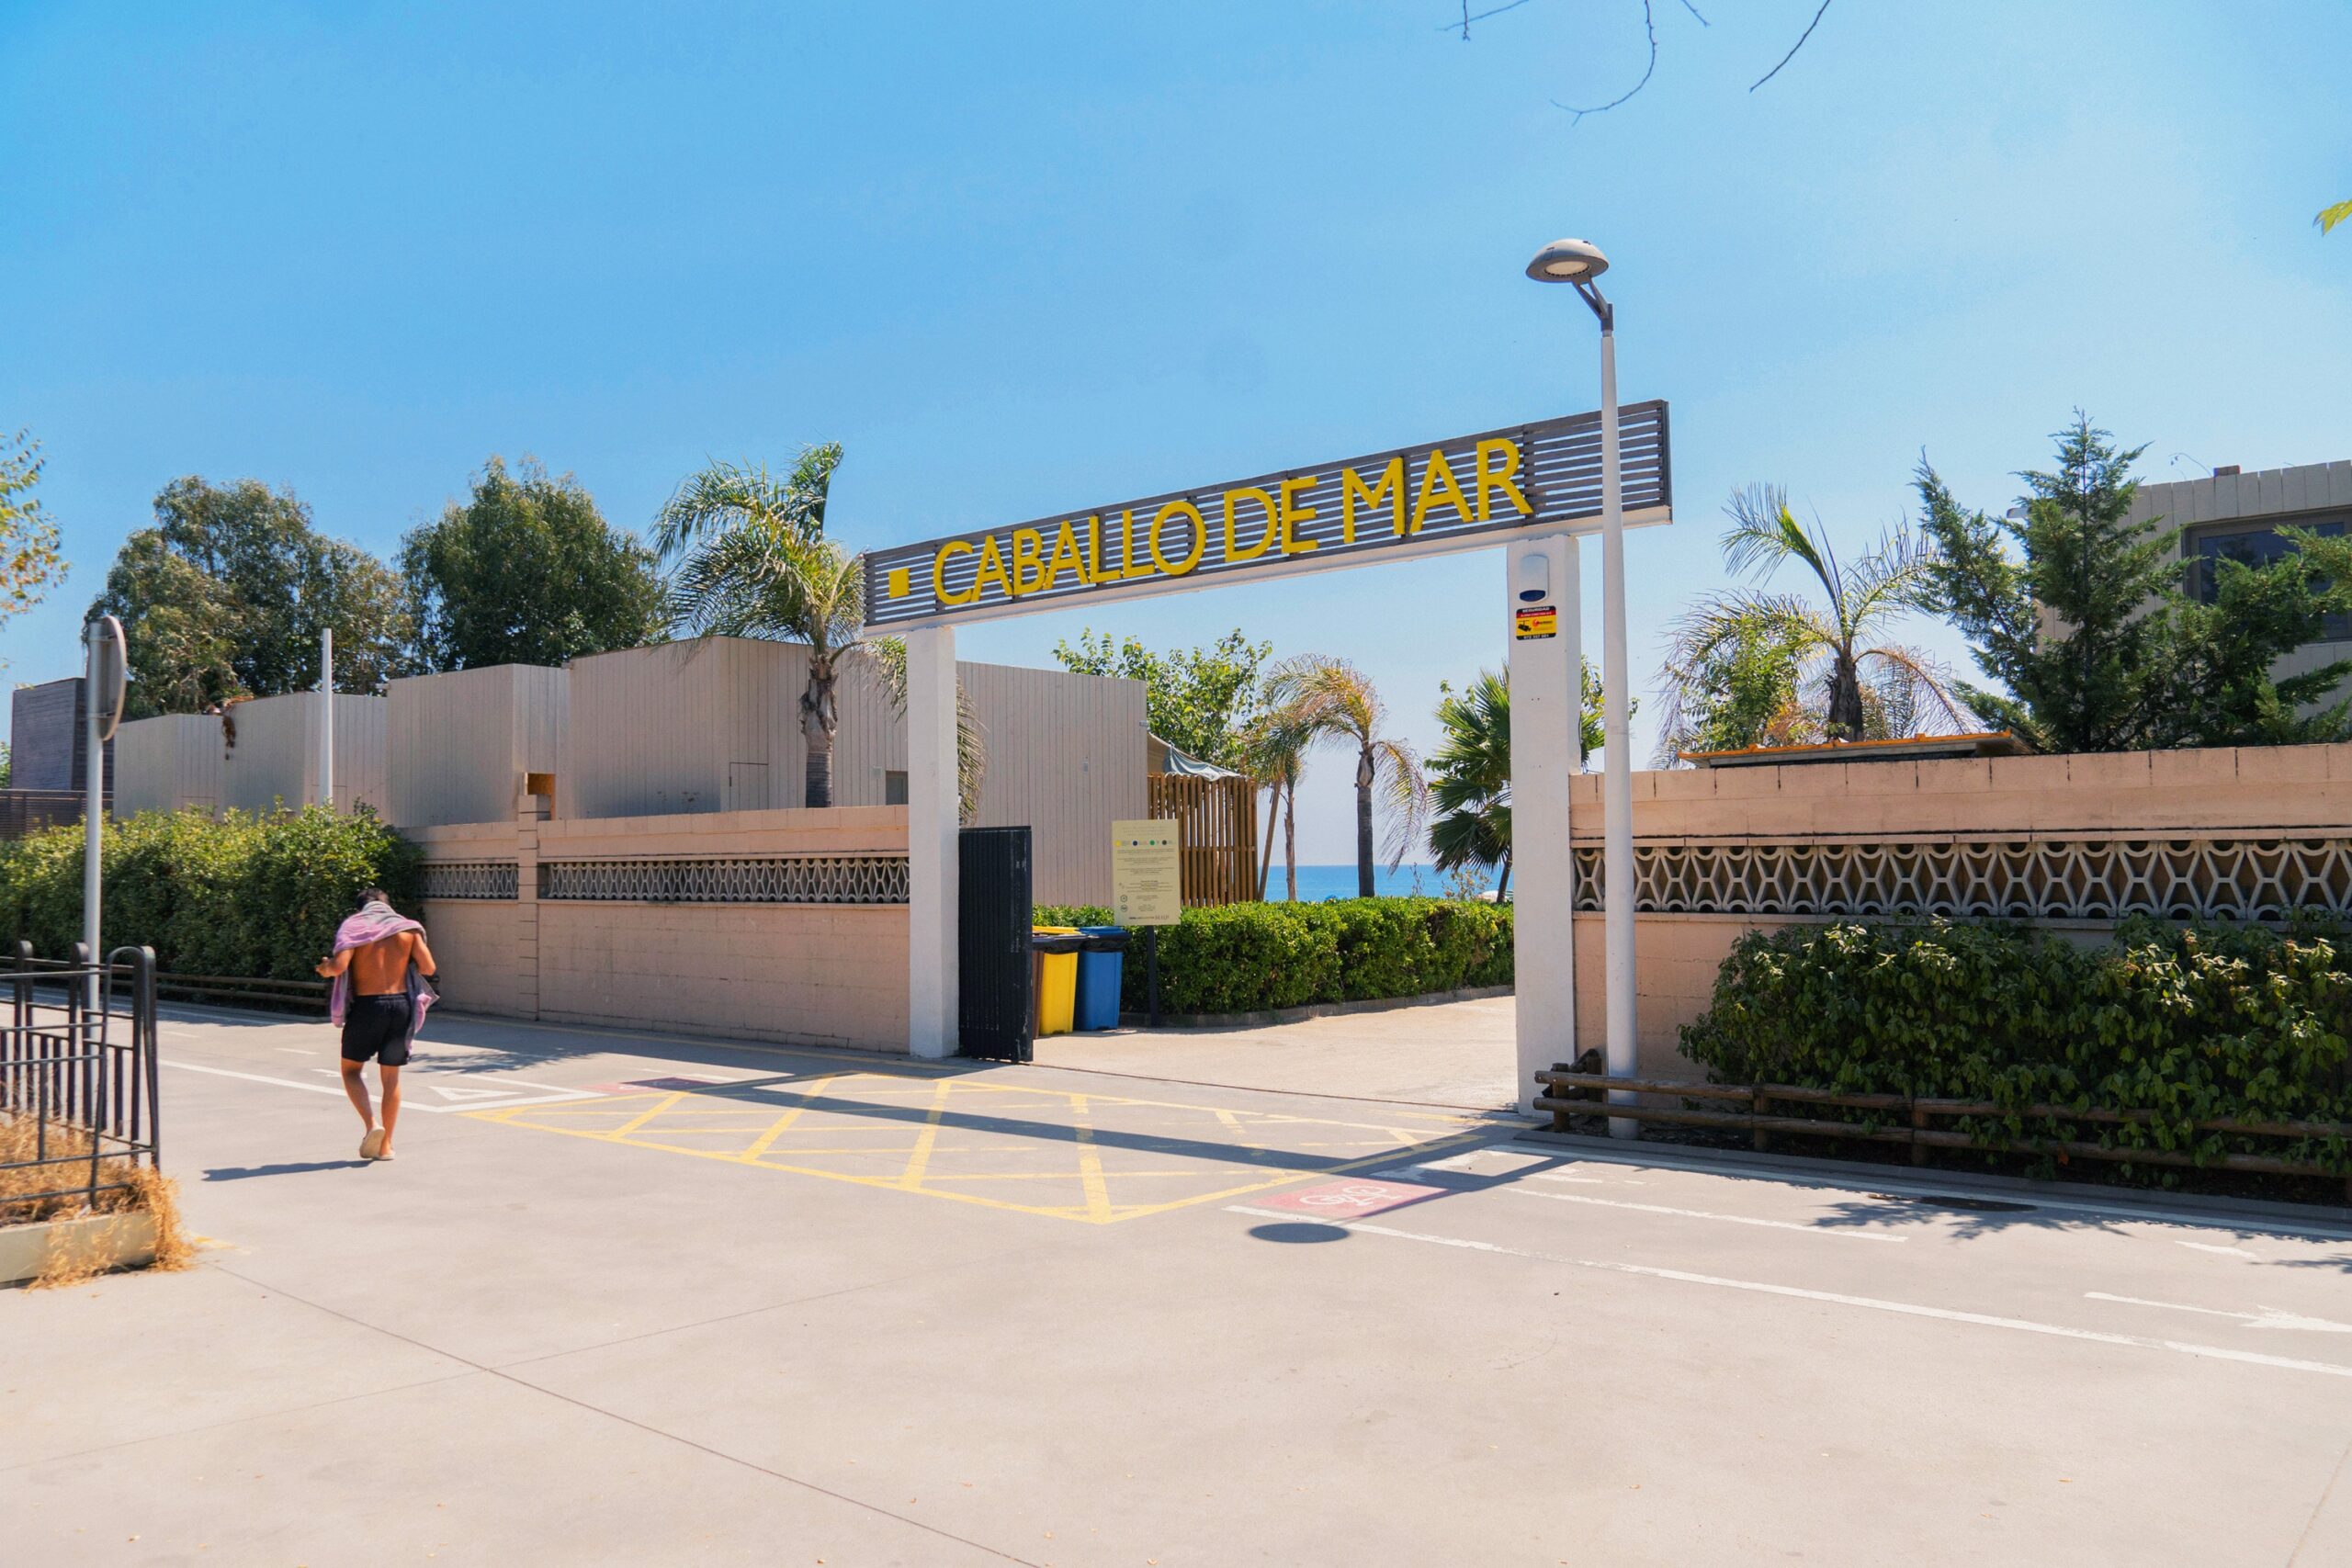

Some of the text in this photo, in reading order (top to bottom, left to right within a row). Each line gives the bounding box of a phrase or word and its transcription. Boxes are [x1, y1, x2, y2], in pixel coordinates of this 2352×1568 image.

[933, 438, 1533, 605] CABALLO DE MAR
